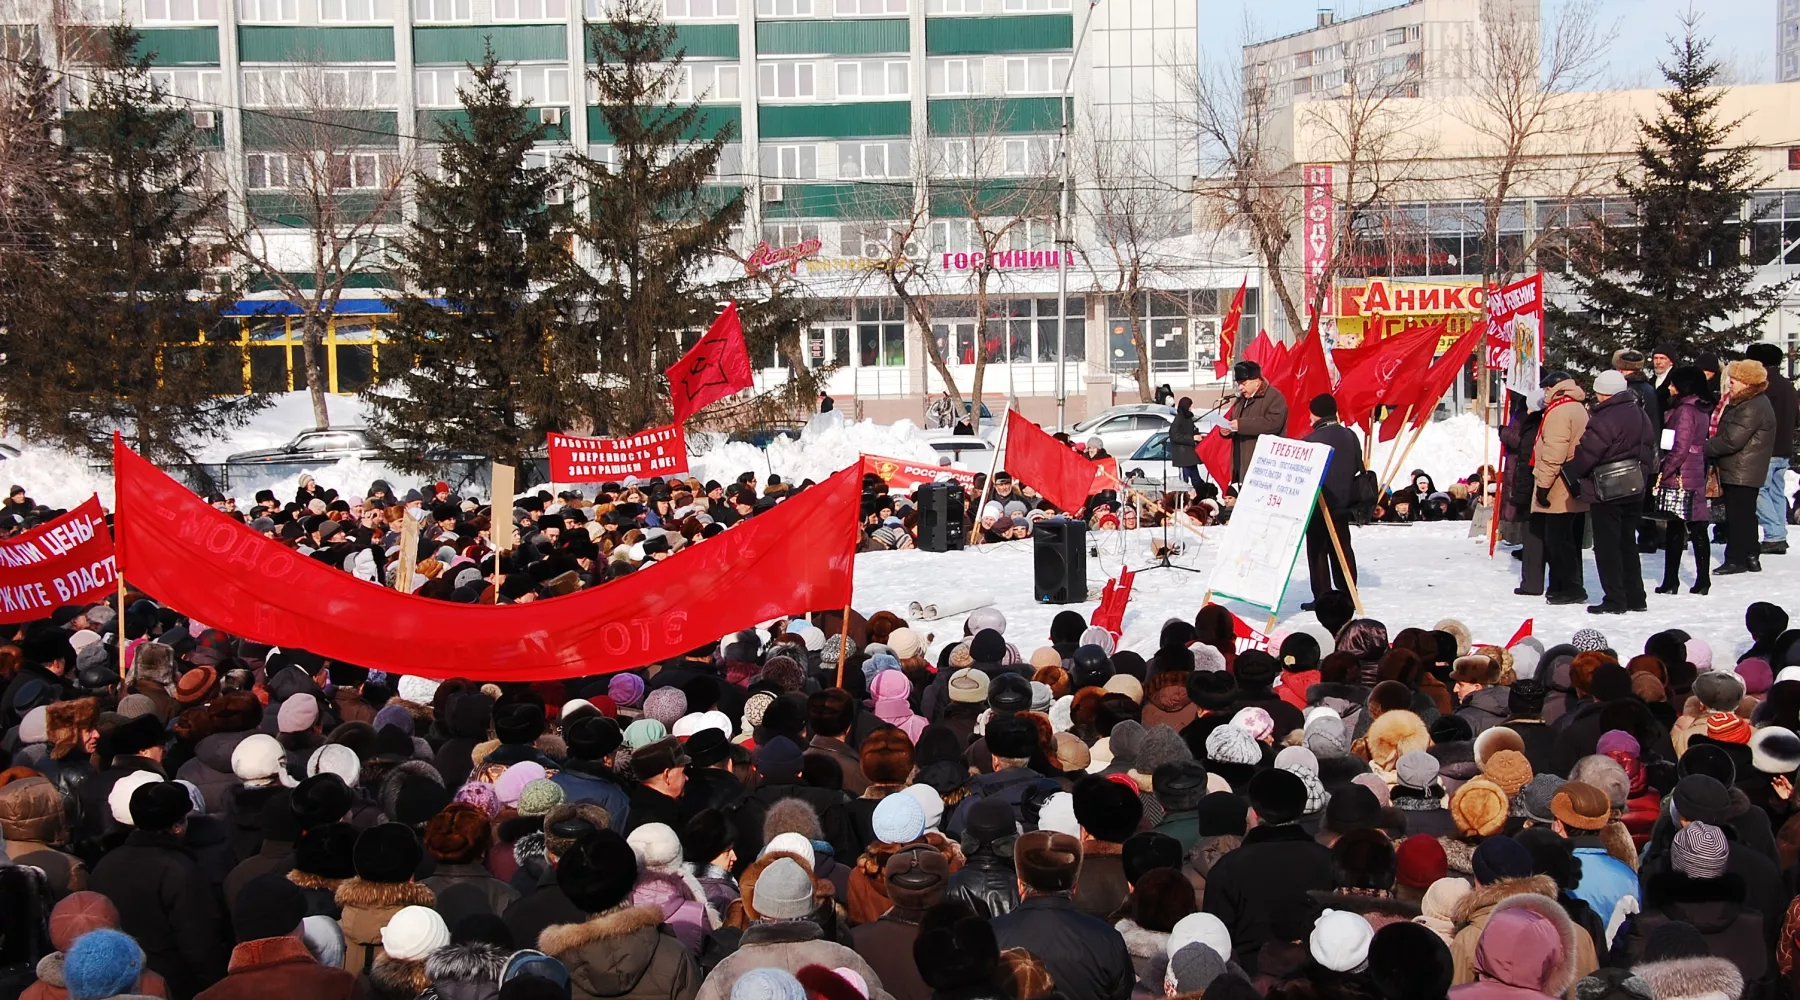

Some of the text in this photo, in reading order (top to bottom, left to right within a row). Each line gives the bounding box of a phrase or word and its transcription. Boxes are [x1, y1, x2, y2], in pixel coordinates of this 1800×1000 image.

[554, 428, 677, 450] РАБОТУ! ЗАРПЛАТУ!
[571, 446, 664, 463] УВЕРЕННОСТЬ В
[1270, 442, 1314, 461] ТРЕБУЕМ!
[568, 456, 677, 476] ЗАВТРАШНЕМ ДНЕ!
[1267, 494, 1282, 508] 354
[0, 582, 52, 613] ЖИТЕ
